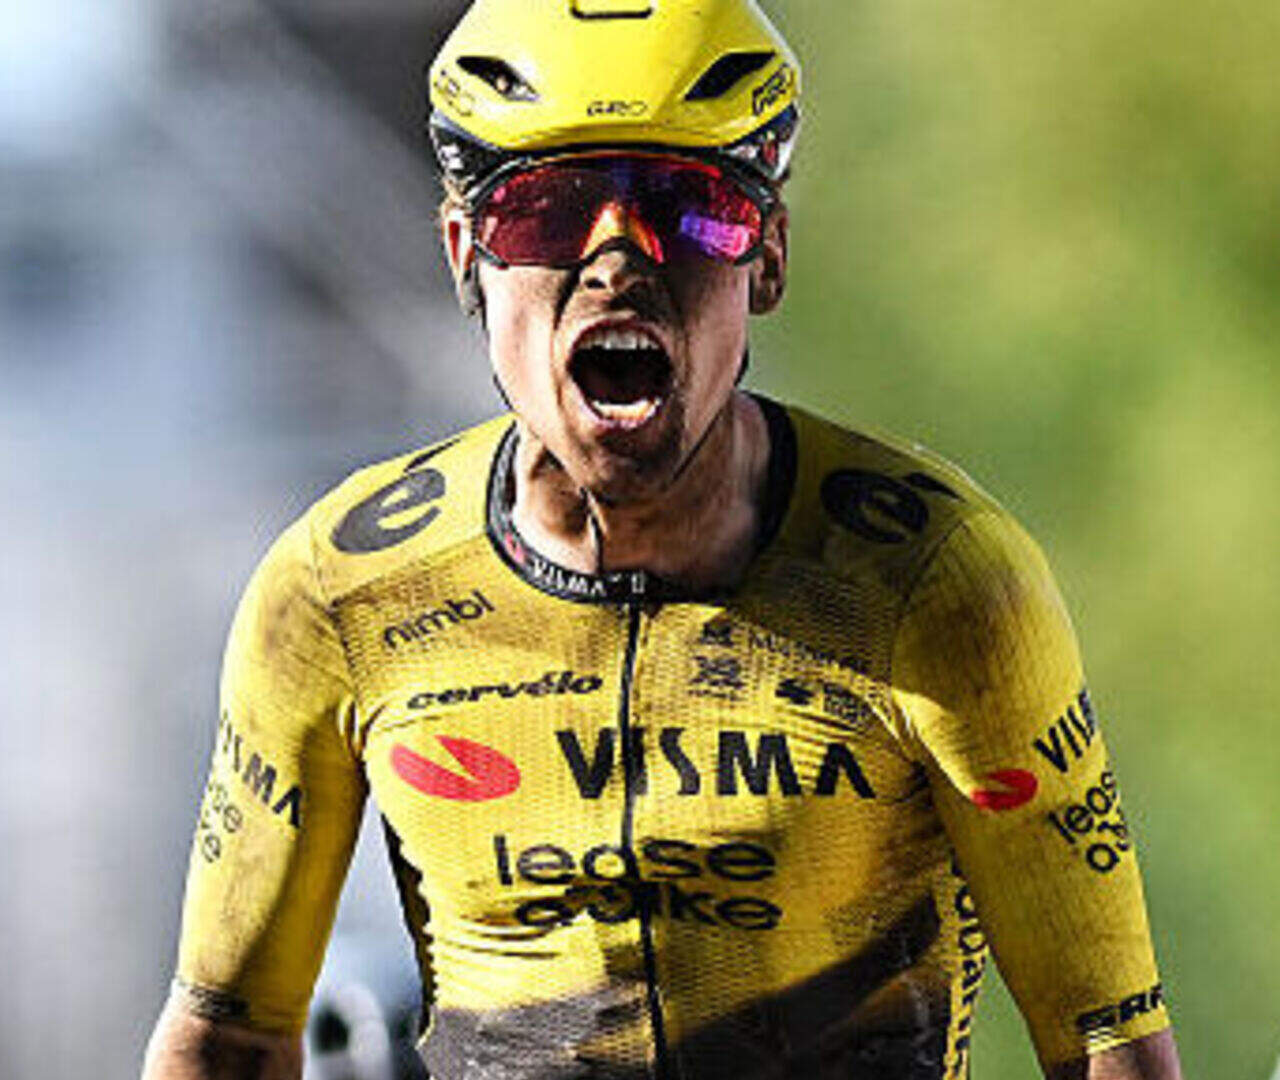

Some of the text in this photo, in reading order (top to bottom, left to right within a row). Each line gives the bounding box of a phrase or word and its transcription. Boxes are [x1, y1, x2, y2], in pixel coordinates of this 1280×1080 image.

[383, 588, 495, 650] nimbl
[555, 727, 877, 800] VISMA
[1049, 771, 1117, 845] leas
[493, 833, 778, 886] lease
